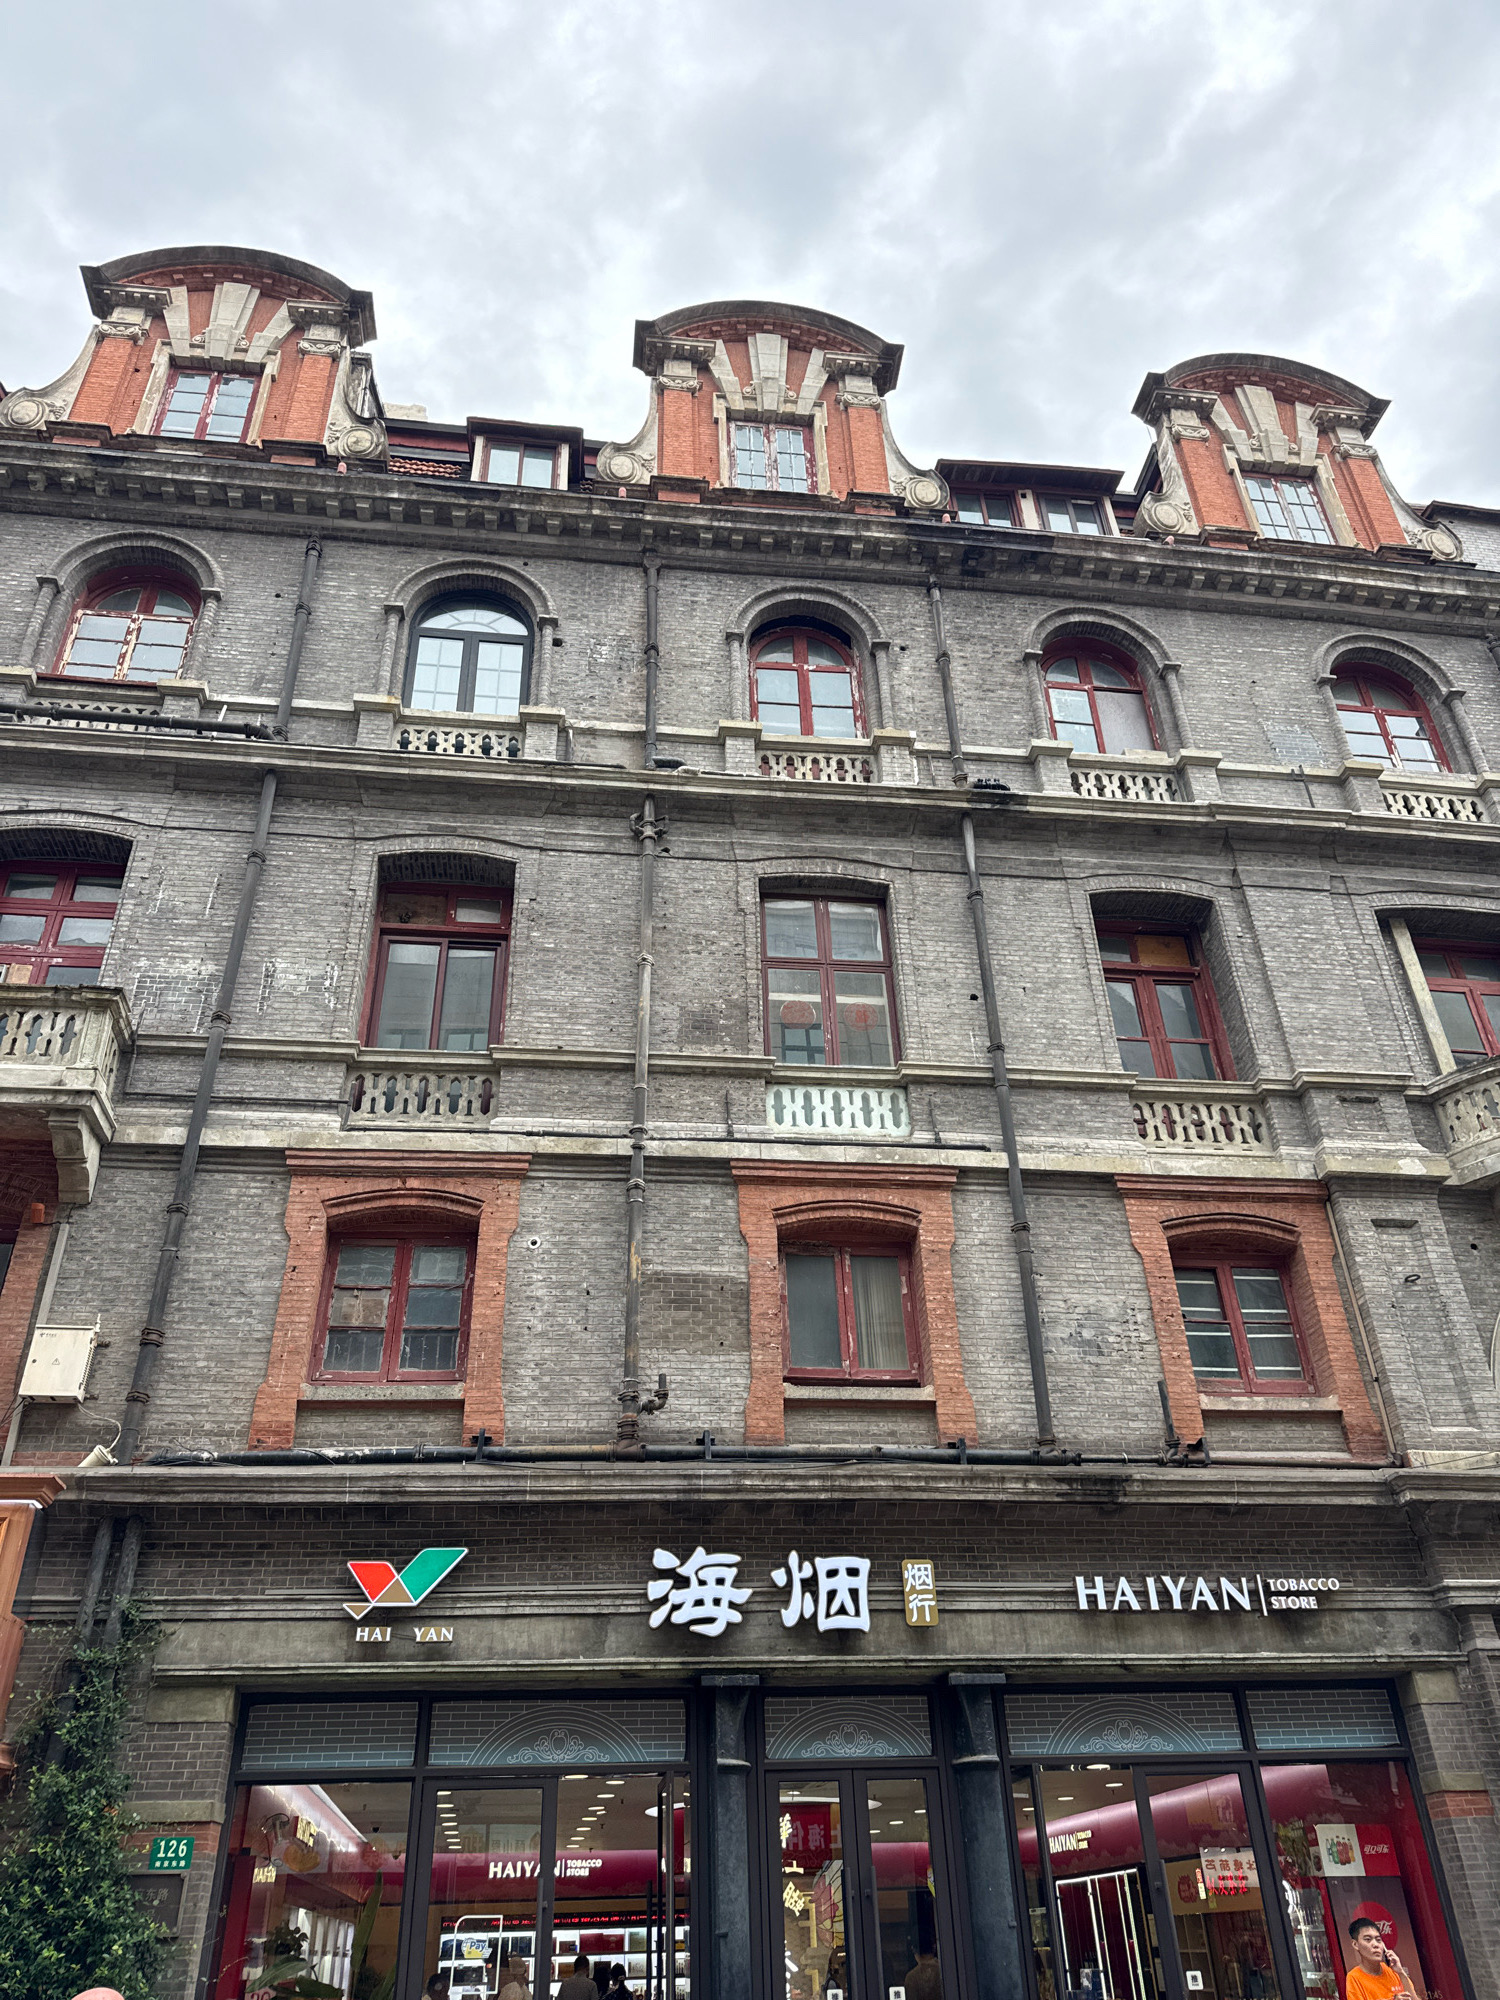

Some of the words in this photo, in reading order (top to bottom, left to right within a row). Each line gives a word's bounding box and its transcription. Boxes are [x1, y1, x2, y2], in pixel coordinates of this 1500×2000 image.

[647, 1546, 871, 1637] 海烟
[1266, 1578, 1340, 1592] TOBACCO
[904, 1562, 936, 1623] 烟行
[1074, 1575, 1252, 1611] HAIYAN
[1271, 1596, 1319, 1610] STORE
[356, 1627, 392, 1642] HAI
[413, 1627, 454, 1642] YAN
[157, 1839, 188, 1858] 126
[1048, 1833, 1078, 1854] HAIYAN
[154, 1860, 186, 1868] 南京东路
[566, 1859, 603, 1868] TOBACCO
[566, 1867, 590, 1877] STORE
[469, 1941, 487, 1953] Pay
